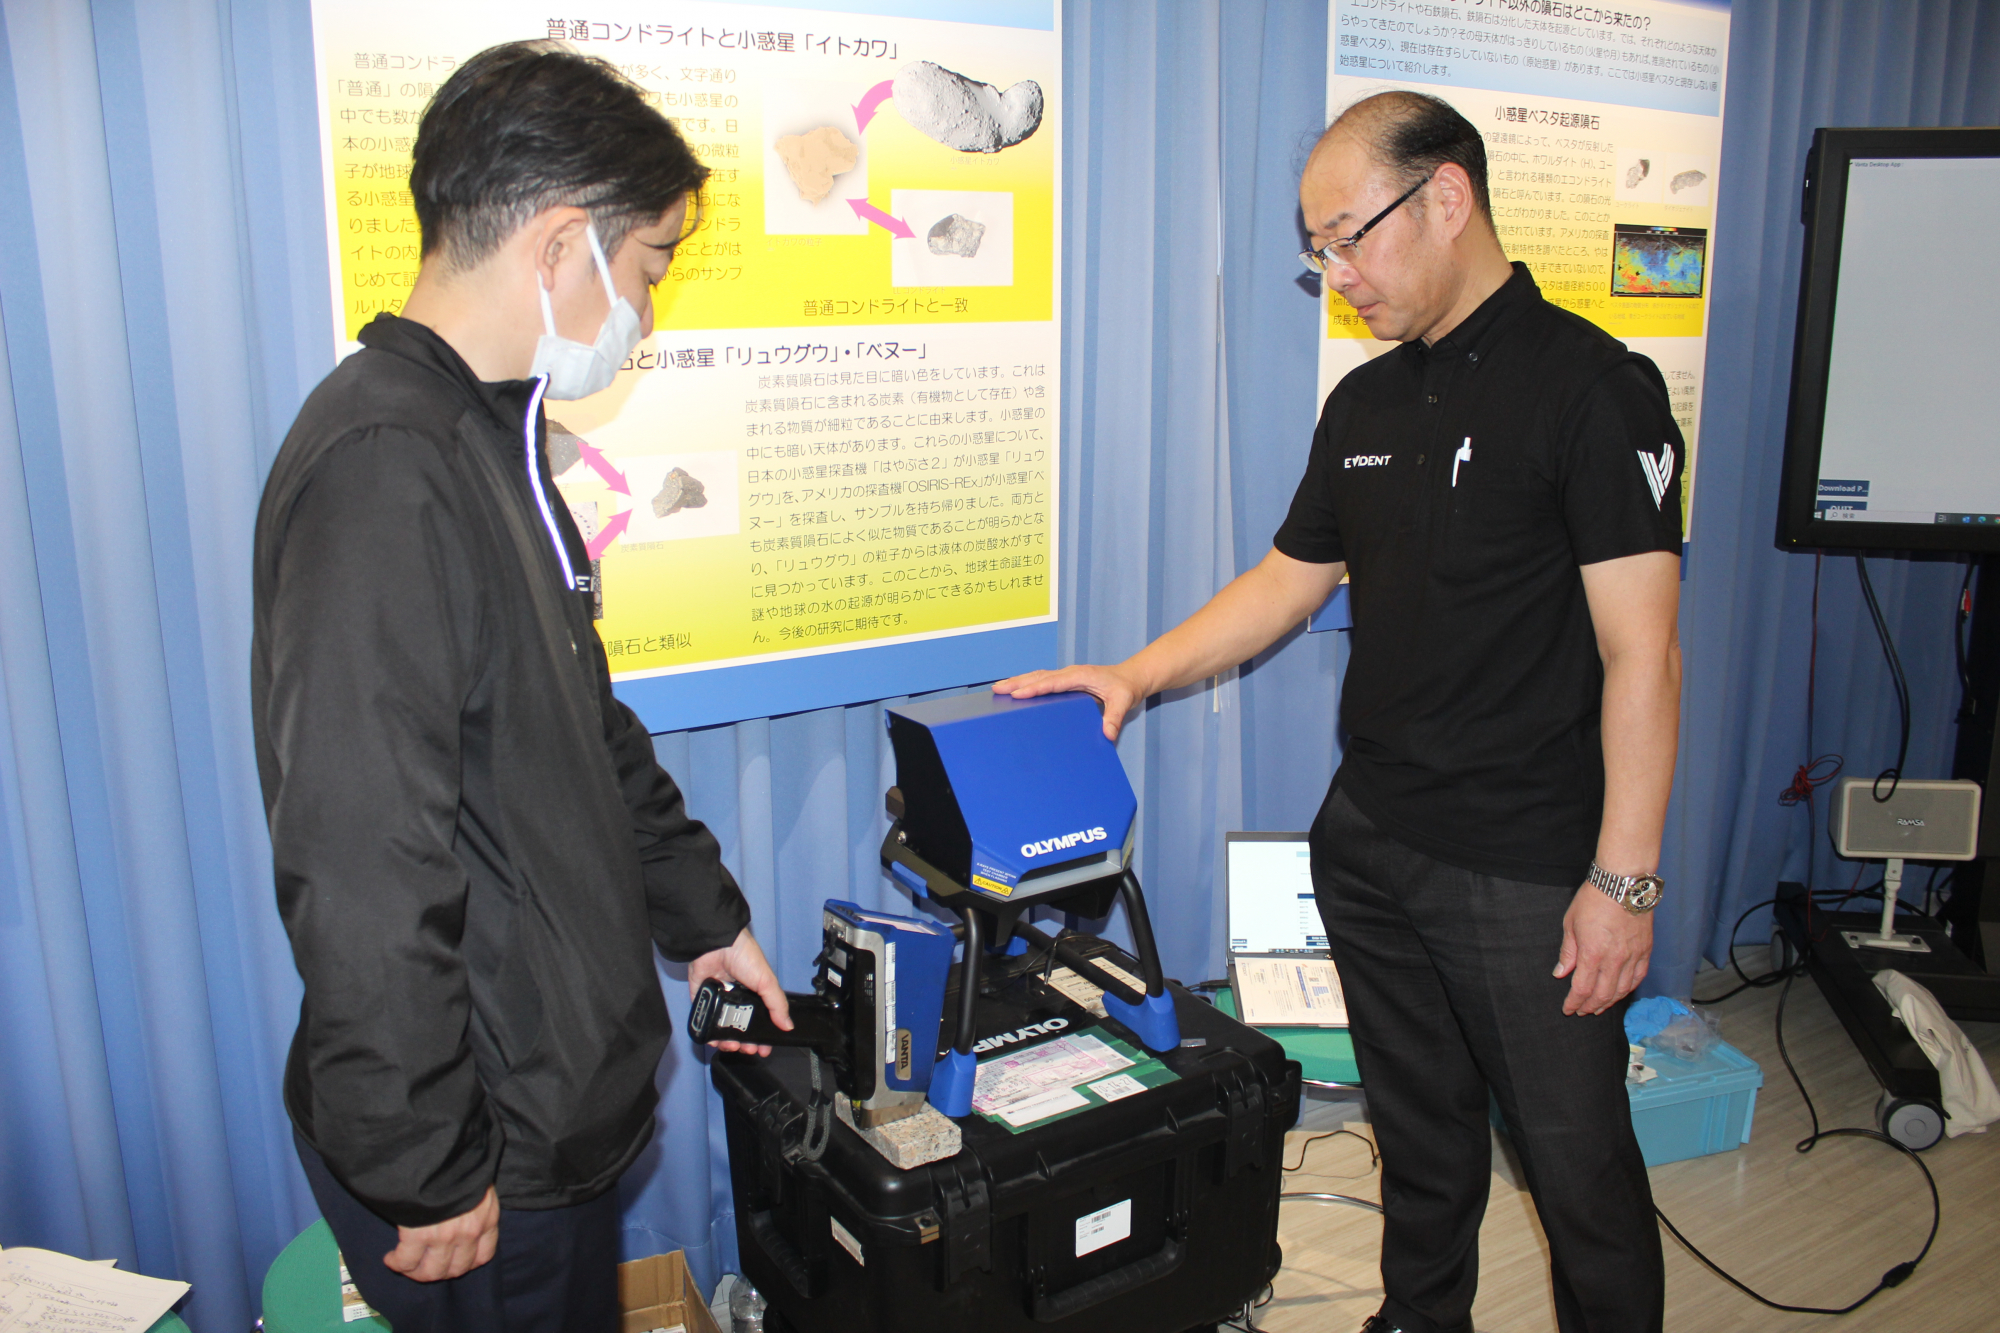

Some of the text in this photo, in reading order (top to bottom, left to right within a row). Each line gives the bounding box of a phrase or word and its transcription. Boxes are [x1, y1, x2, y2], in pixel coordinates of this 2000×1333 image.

[546, 18, 898, 60] 普通コンドライトと小惑星「イトカワ」
[354, 53, 466, 71] 普通コンドラ
[1339, 54, 1452, 77] 始惑星について紹介します。
[1495, 105, 1601, 130] 小惑星ベスタ起源隕石
[1478, 131, 1615, 153] の望遠鏡によって、ベスタが反射した
[803, 297, 969, 316] 普通コンドライトと一致
[1344, 455, 1393, 469] EVIDENT
[752, 613, 908, 643] ん。今後の研究に期待です。
[602, 632, 692, 657] 隕石と類似
[1020, 826, 1108, 858] OLYMPUS
[972, 1017, 1069, 1053] OLYMP
[900, 1033, 910, 1070] VANTA
